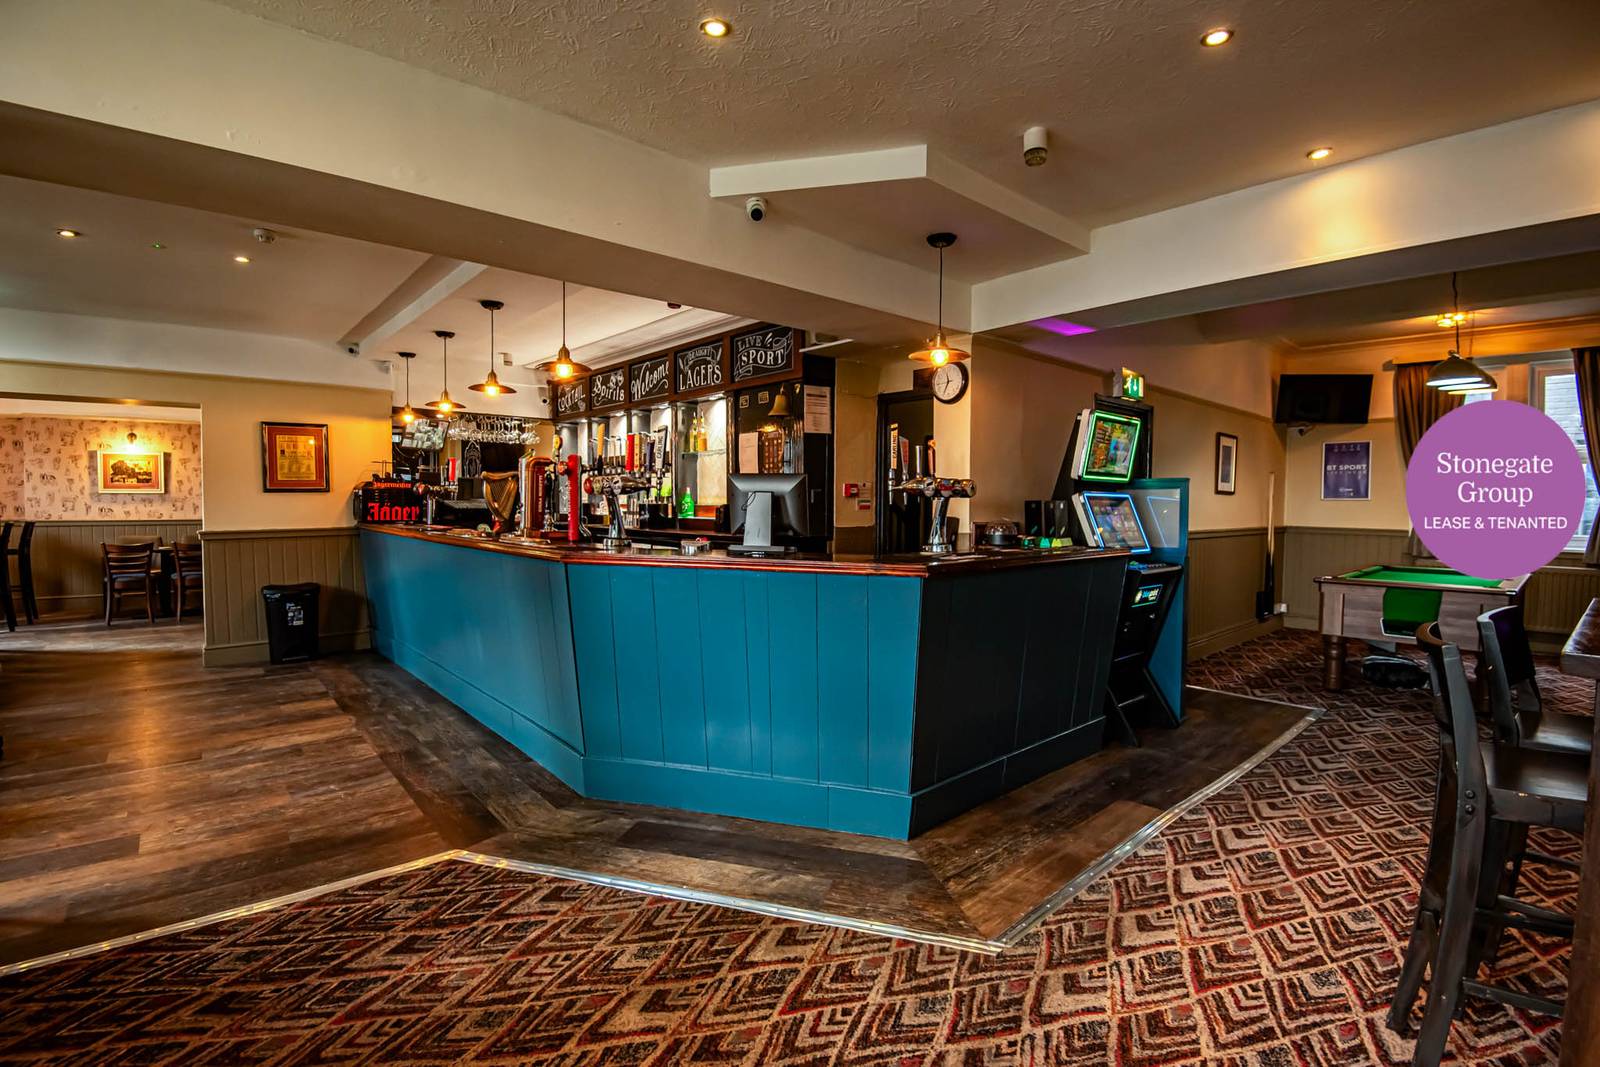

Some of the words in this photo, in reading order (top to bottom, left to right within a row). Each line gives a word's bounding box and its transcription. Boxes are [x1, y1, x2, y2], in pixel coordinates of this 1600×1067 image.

[738, 335, 763, 351] LIVE
[741, 349, 784, 366] SPORT
[631, 361, 669, 401] Welcome
[680, 364, 722, 390] LAGERS
[591, 375, 625, 406] Spirits
[656, 436, 664, 459] CARLING
[367, 502, 420, 521] Jäger
